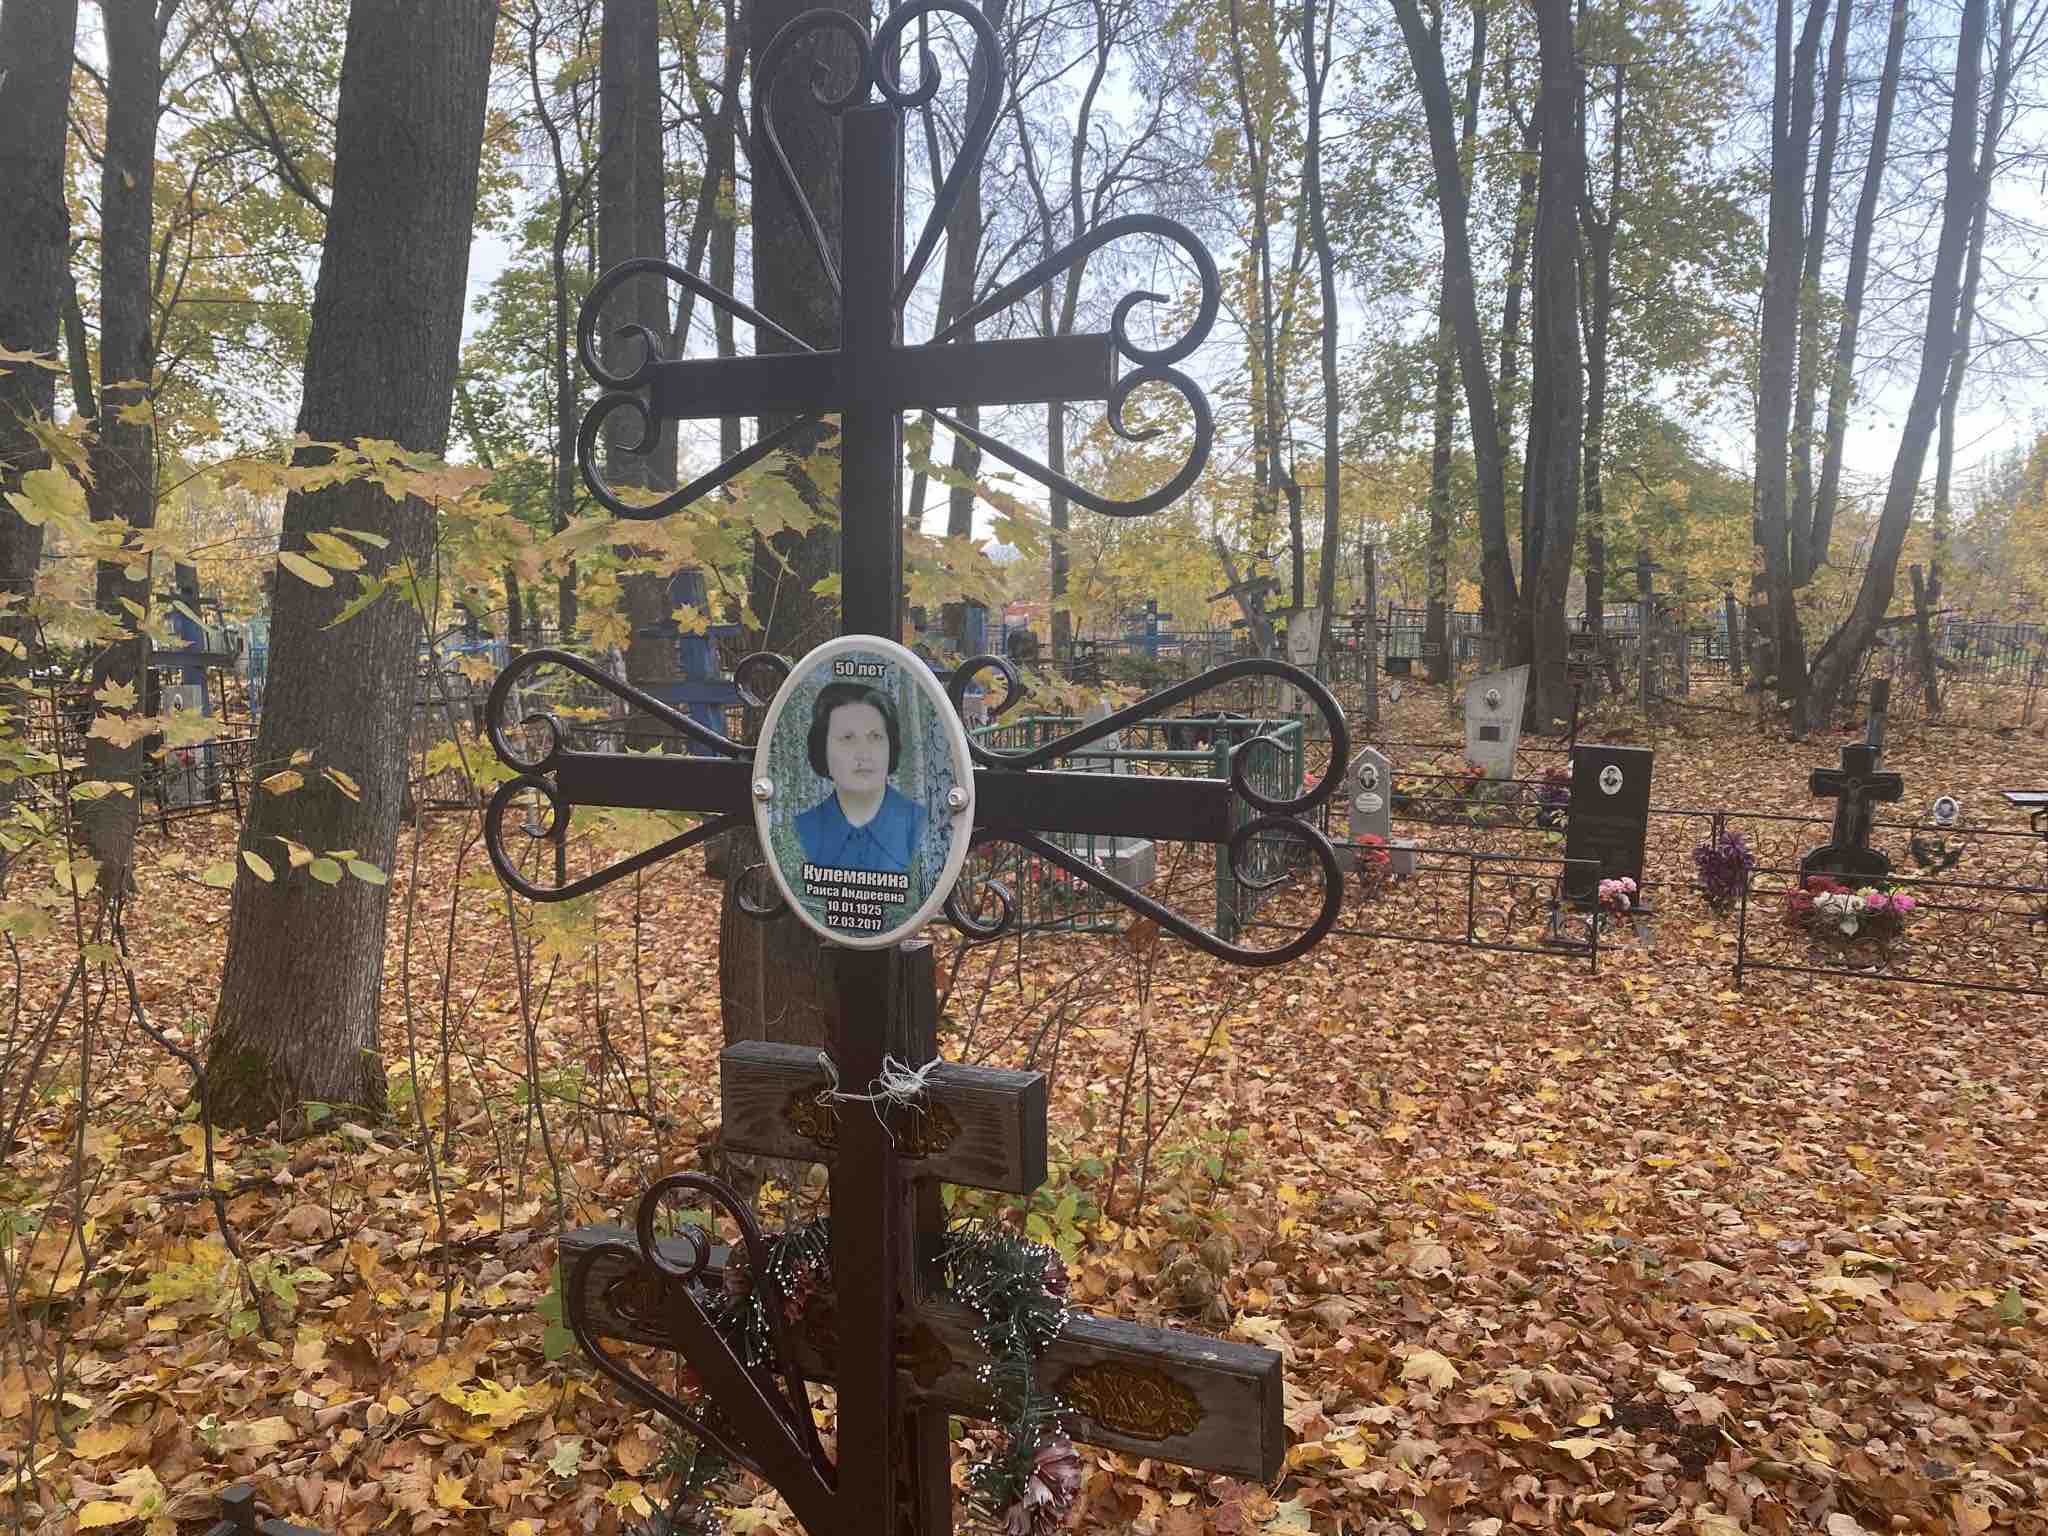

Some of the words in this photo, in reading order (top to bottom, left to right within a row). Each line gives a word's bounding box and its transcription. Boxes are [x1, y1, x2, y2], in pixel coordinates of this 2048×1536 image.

[835, 662, 854, 675] 50
[858, 664, 885, 676] лет
[803, 863, 909, 889] Кулемякина
[806, 883, 839, 897] Раиса
[841, 887, 905, 903] Андреевна
[827, 900, 882, 916] 10.01.1925
[827, 915, 882, 930] 12.03.2017
